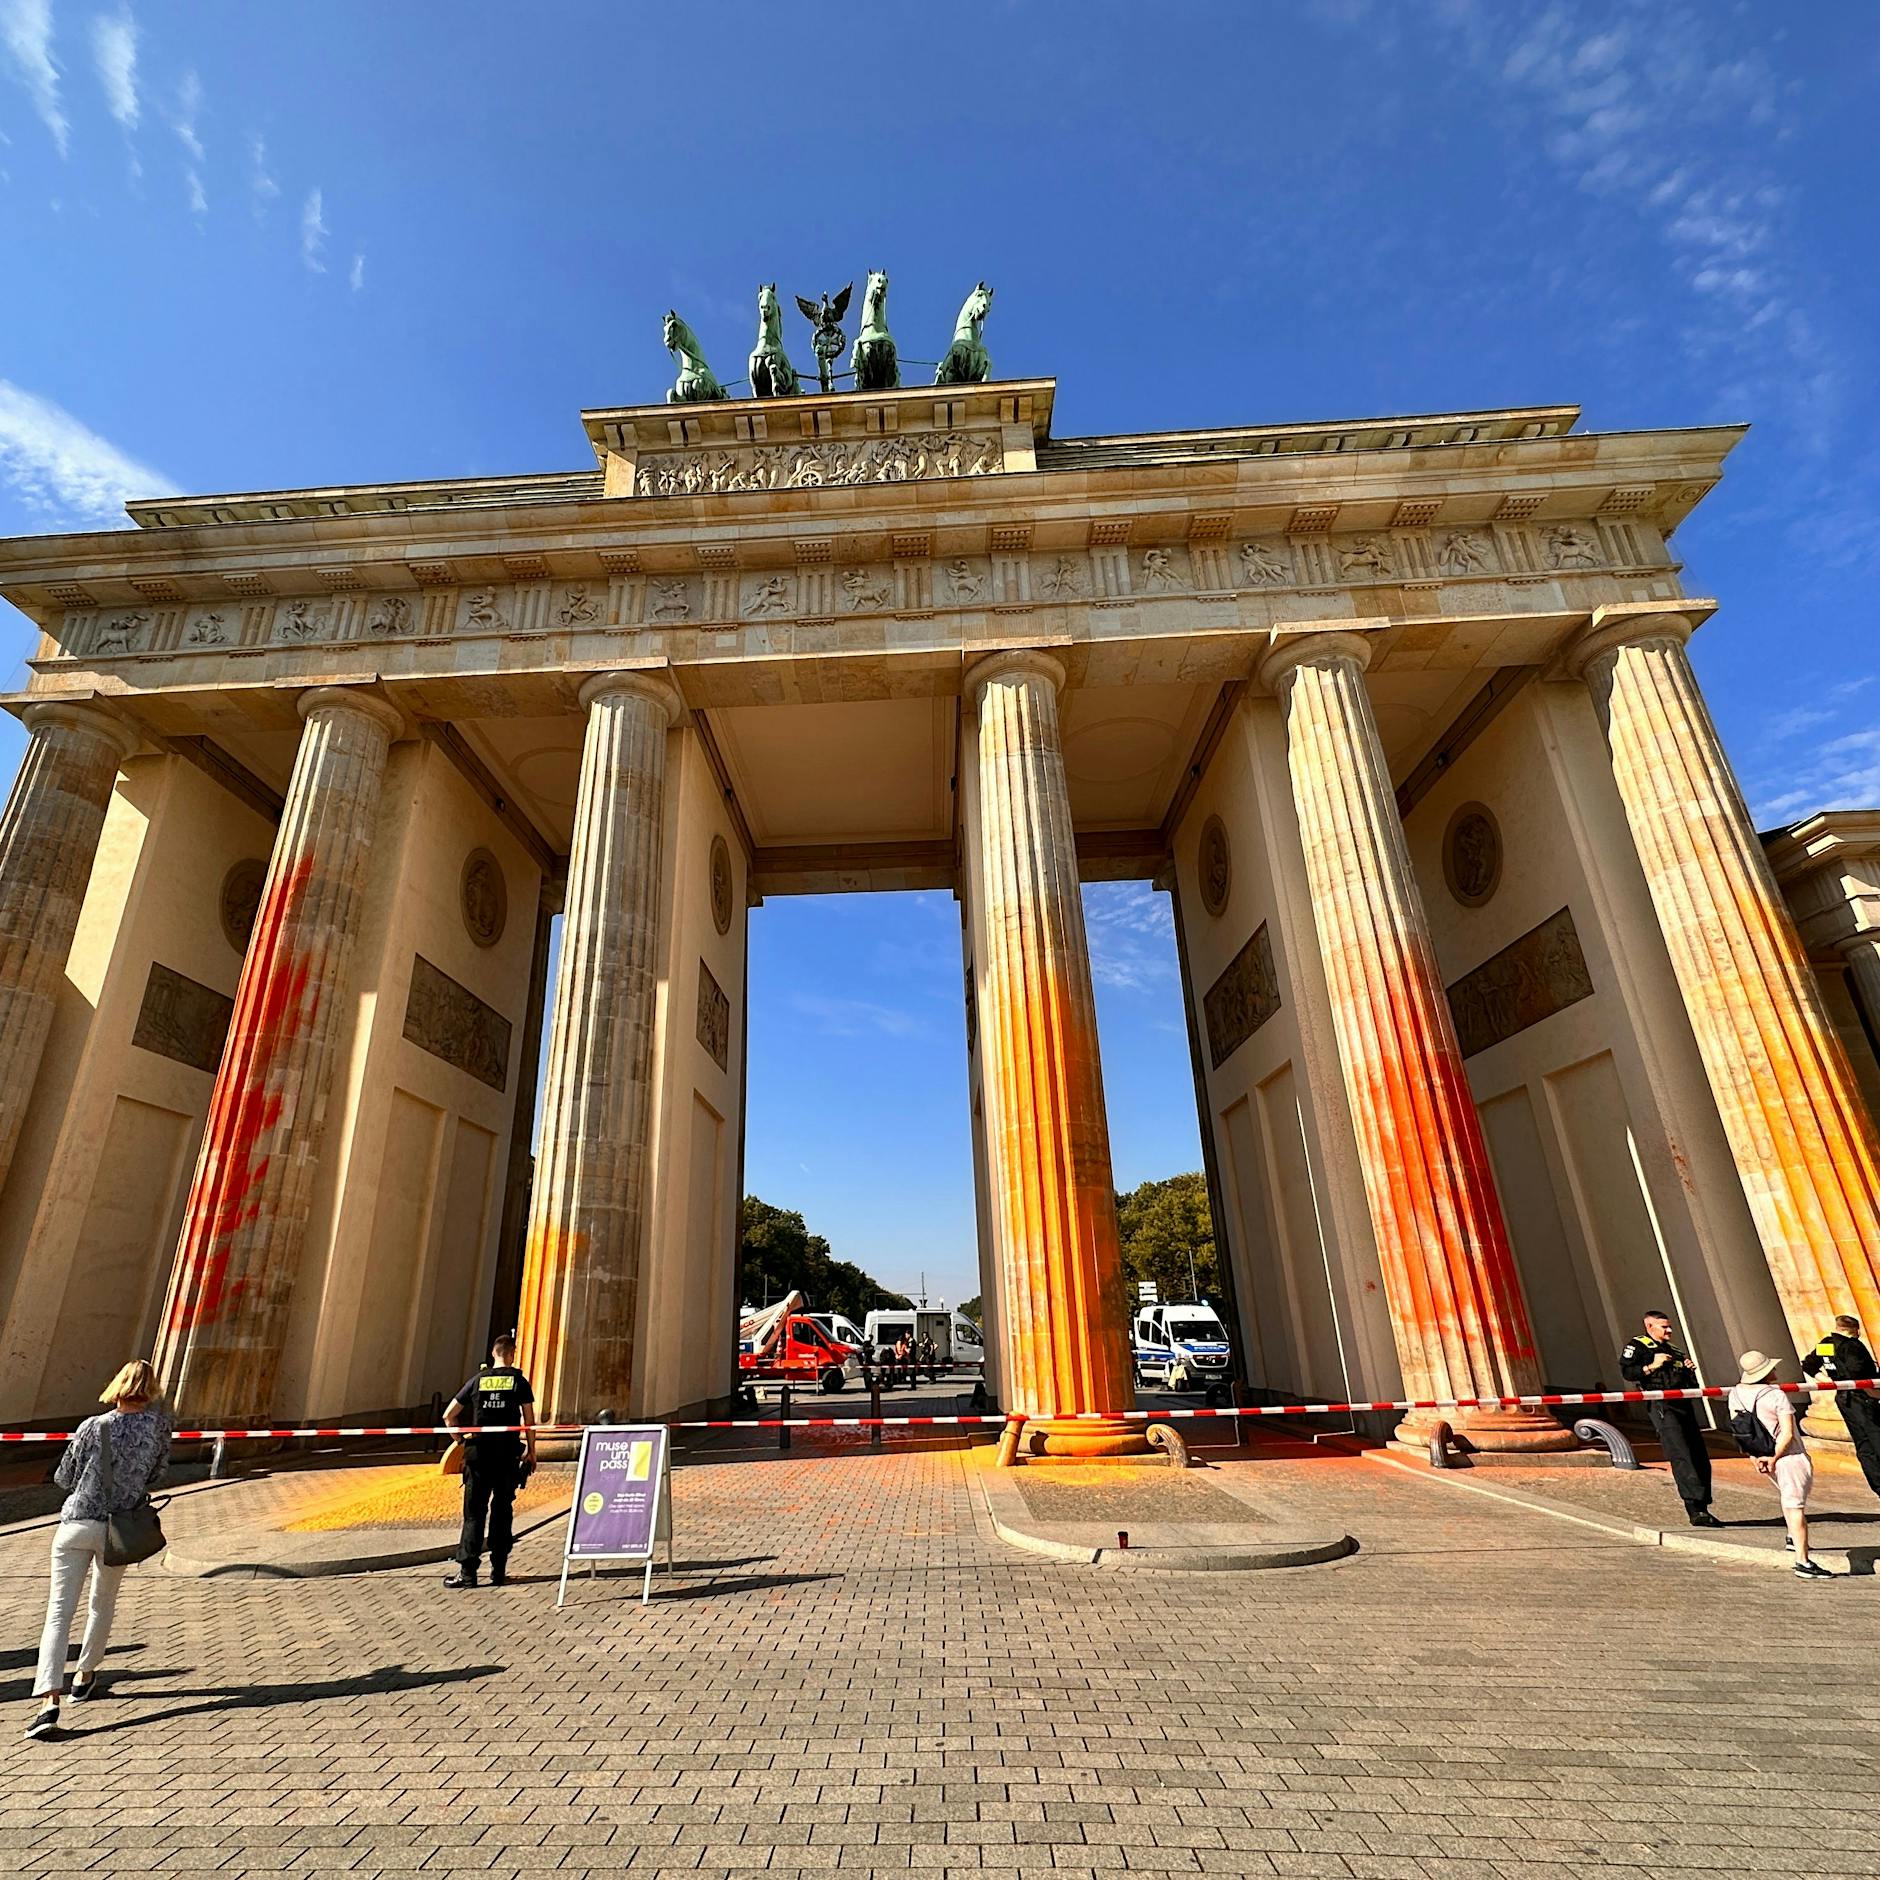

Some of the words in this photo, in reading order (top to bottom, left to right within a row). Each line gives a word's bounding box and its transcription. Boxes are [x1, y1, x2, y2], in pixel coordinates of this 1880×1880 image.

[595, 1441, 629, 1451] muse
[611, 1450, 630, 1460] um
[599, 1460, 628, 1472] pass
